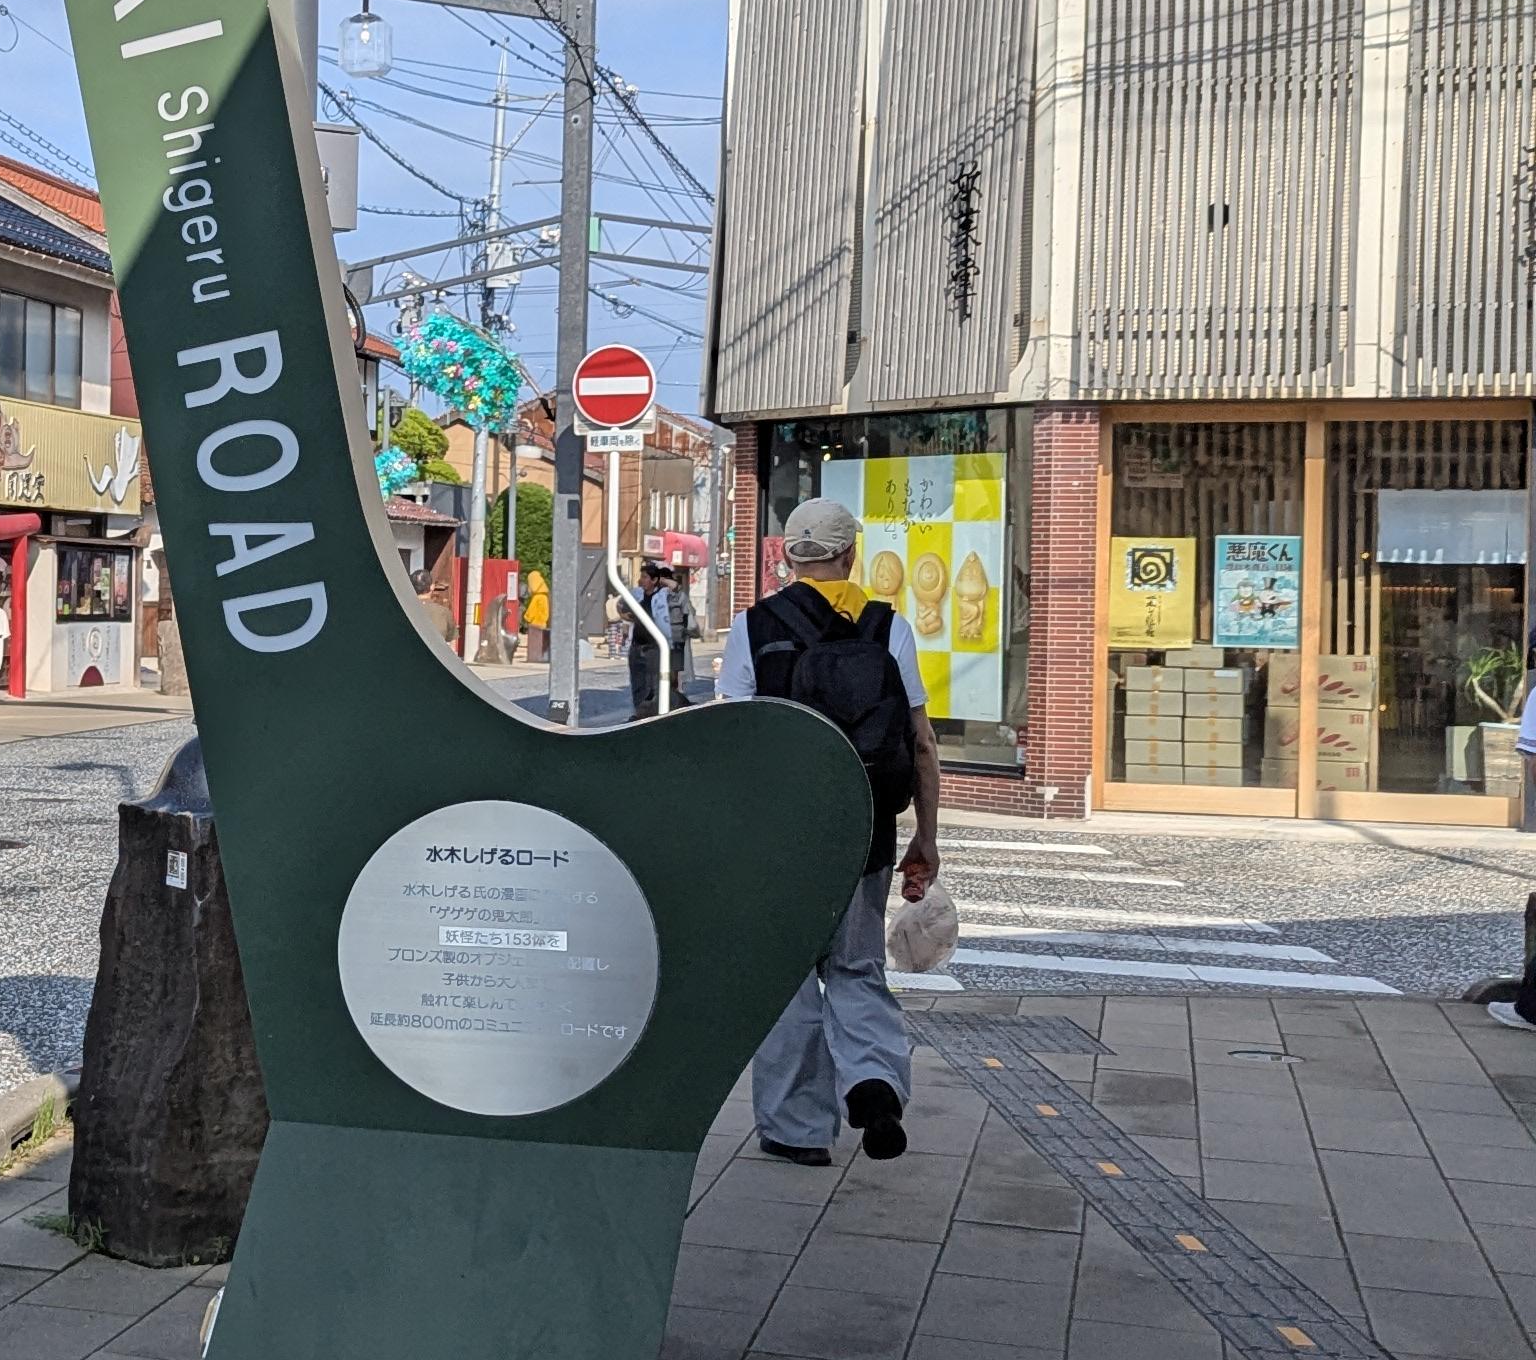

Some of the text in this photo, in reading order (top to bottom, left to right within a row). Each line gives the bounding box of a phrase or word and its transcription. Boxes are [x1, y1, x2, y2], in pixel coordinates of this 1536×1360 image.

[156, 86, 234, 305] Shigeru
[175, 330, 330, 653] ROAD
[901, 478, 916, 533] もなか
[920, 478, 933, 534] かわいい
[1226, 542, 1293, 561] 悪魔くん
[426, 846, 569, 867] 水木しげるロード
